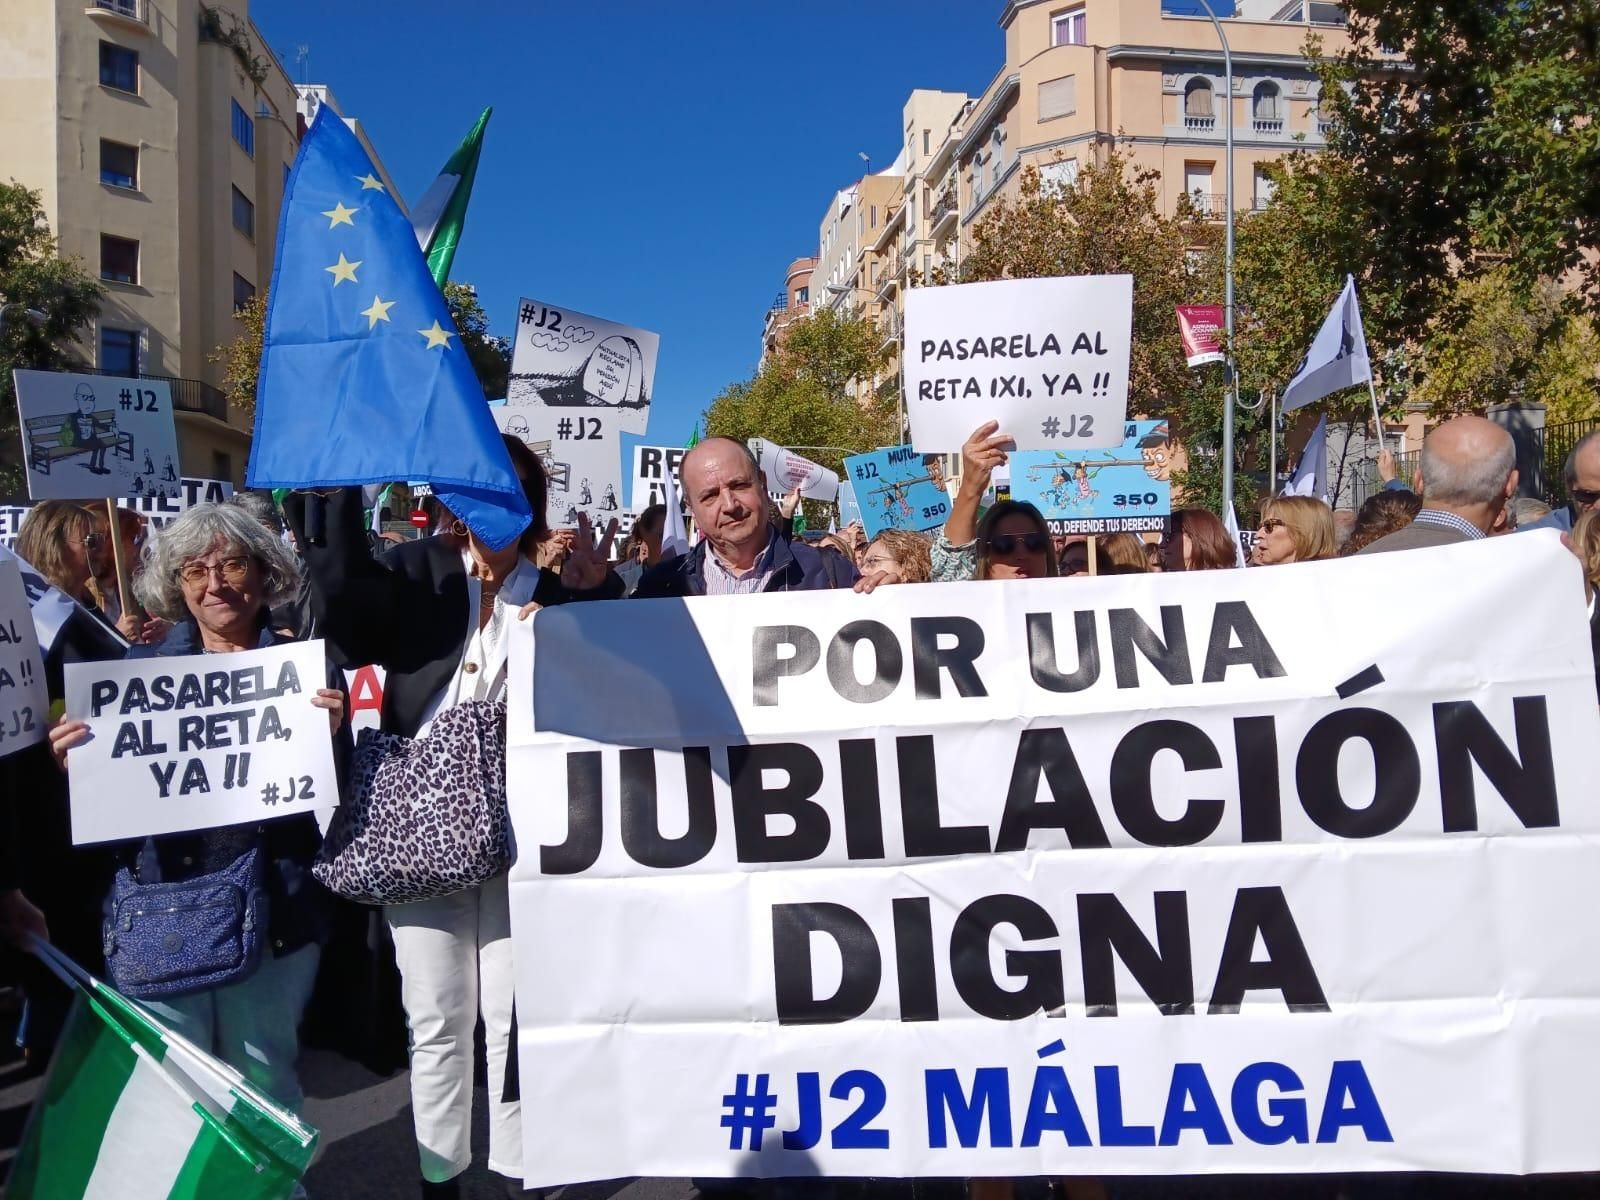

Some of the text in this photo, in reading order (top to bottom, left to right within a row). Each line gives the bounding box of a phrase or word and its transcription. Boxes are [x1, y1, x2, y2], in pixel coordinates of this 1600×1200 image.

[520, 303, 562, 333] #J2
[920, 331, 1109, 363] PASARELA AL
[119, 388, 159, 412] #J2
[918, 372, 1110, 401] RETA IXI, YA !!
[557, 417, 603, 440] #J2
[1041, 414, 1094, 438] #J2
[856, 462, 879, 481] #J2
[920, 502, 947, 519] 350
[1113, 492, 1158, 506] 350
[1064, 519, 1104, 534] DEFIENDE
[1106, 519, 1120, 532] TUS
[1121, 517, 1165, 531] DERECHOS
[752, 600, 1288, 707] POR UNA
[91, 660, 302, 718] PASARELA
[111, 705, 292, 759] AL RETA,
[149, 752, 252, 798] YA !!
[540, 663, 1561, 875] JUBILACIÓN
[261, 776, 316, 806] #J2
[772, 885, 1332, 1025] DIGNA
[720, 1038, 1395, 1152] #J2 MÁLAGA
